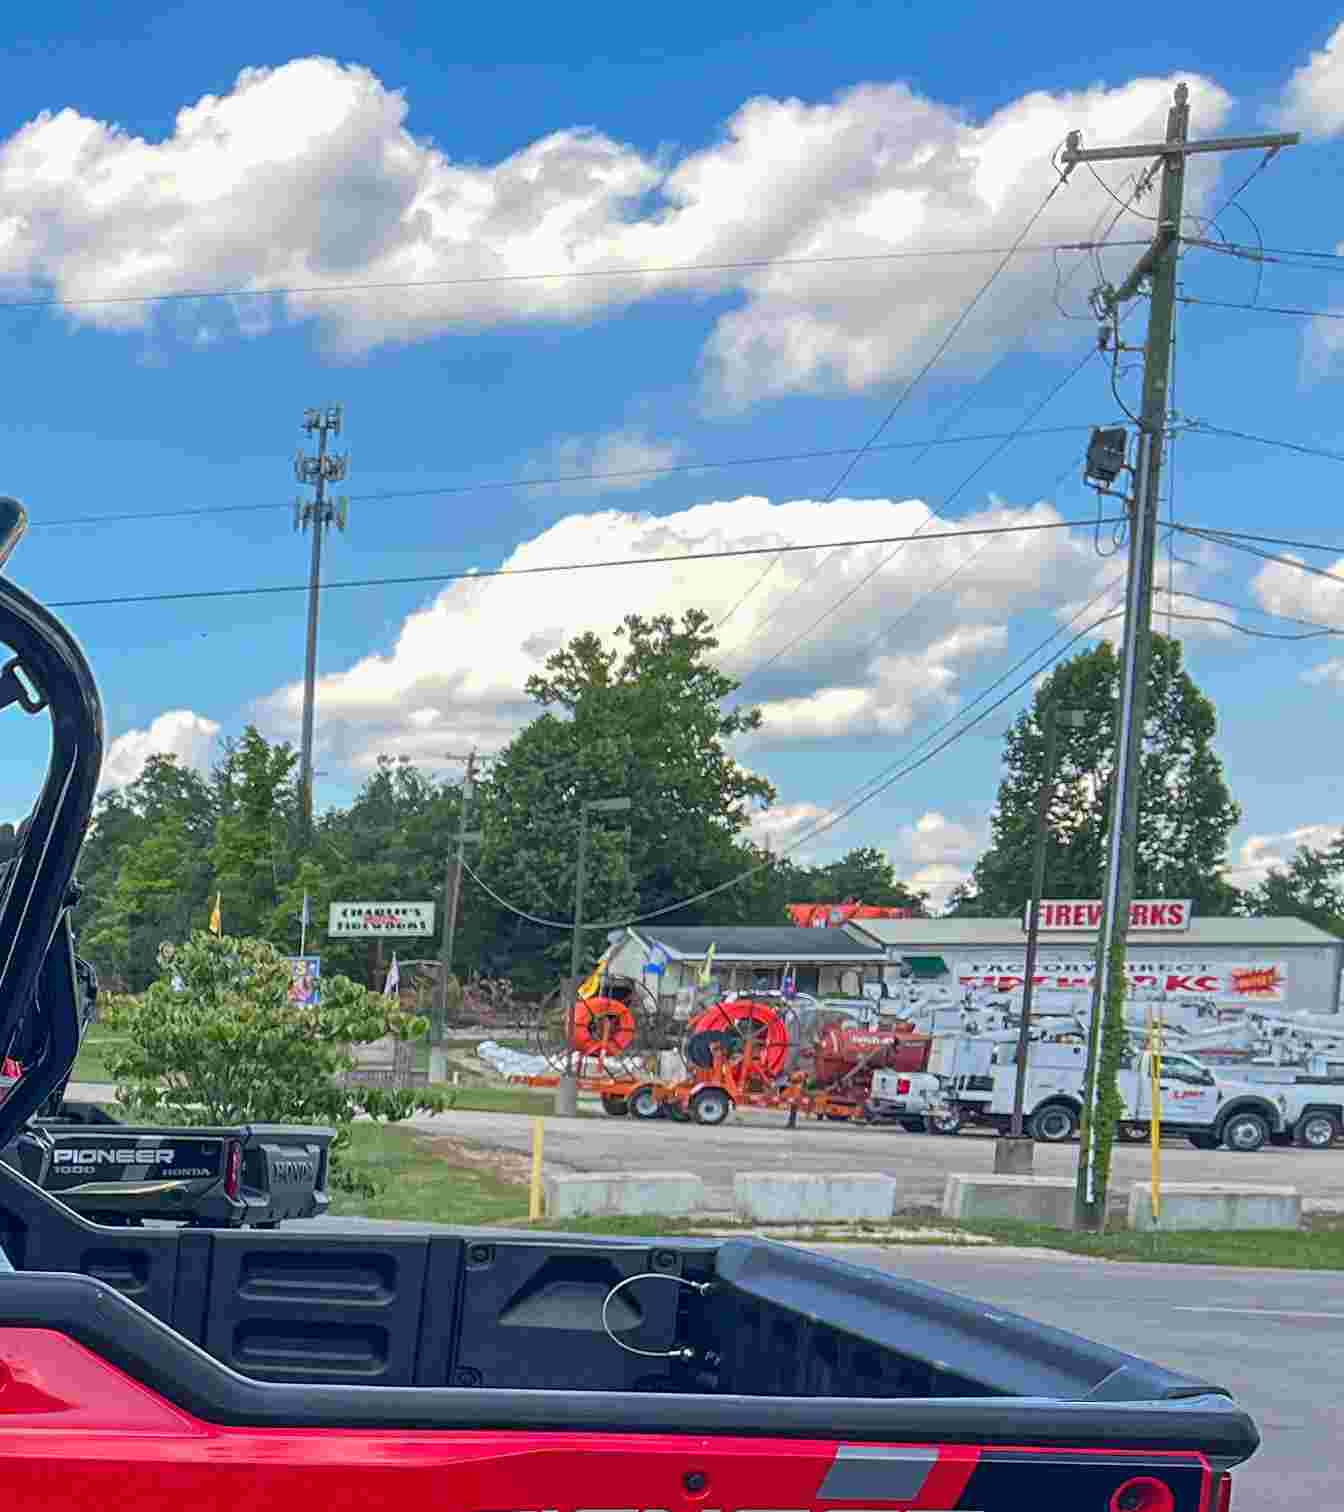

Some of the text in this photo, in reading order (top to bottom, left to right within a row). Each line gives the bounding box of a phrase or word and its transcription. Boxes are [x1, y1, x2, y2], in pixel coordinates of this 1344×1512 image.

[1034, 903, 1185, 927] FIREWRKS
[971, 963, 1212, 973] FACORY IRECT
[52, 1149, 176, 1164] PIONEER
[52, 1165, 96, 1175] 1000
